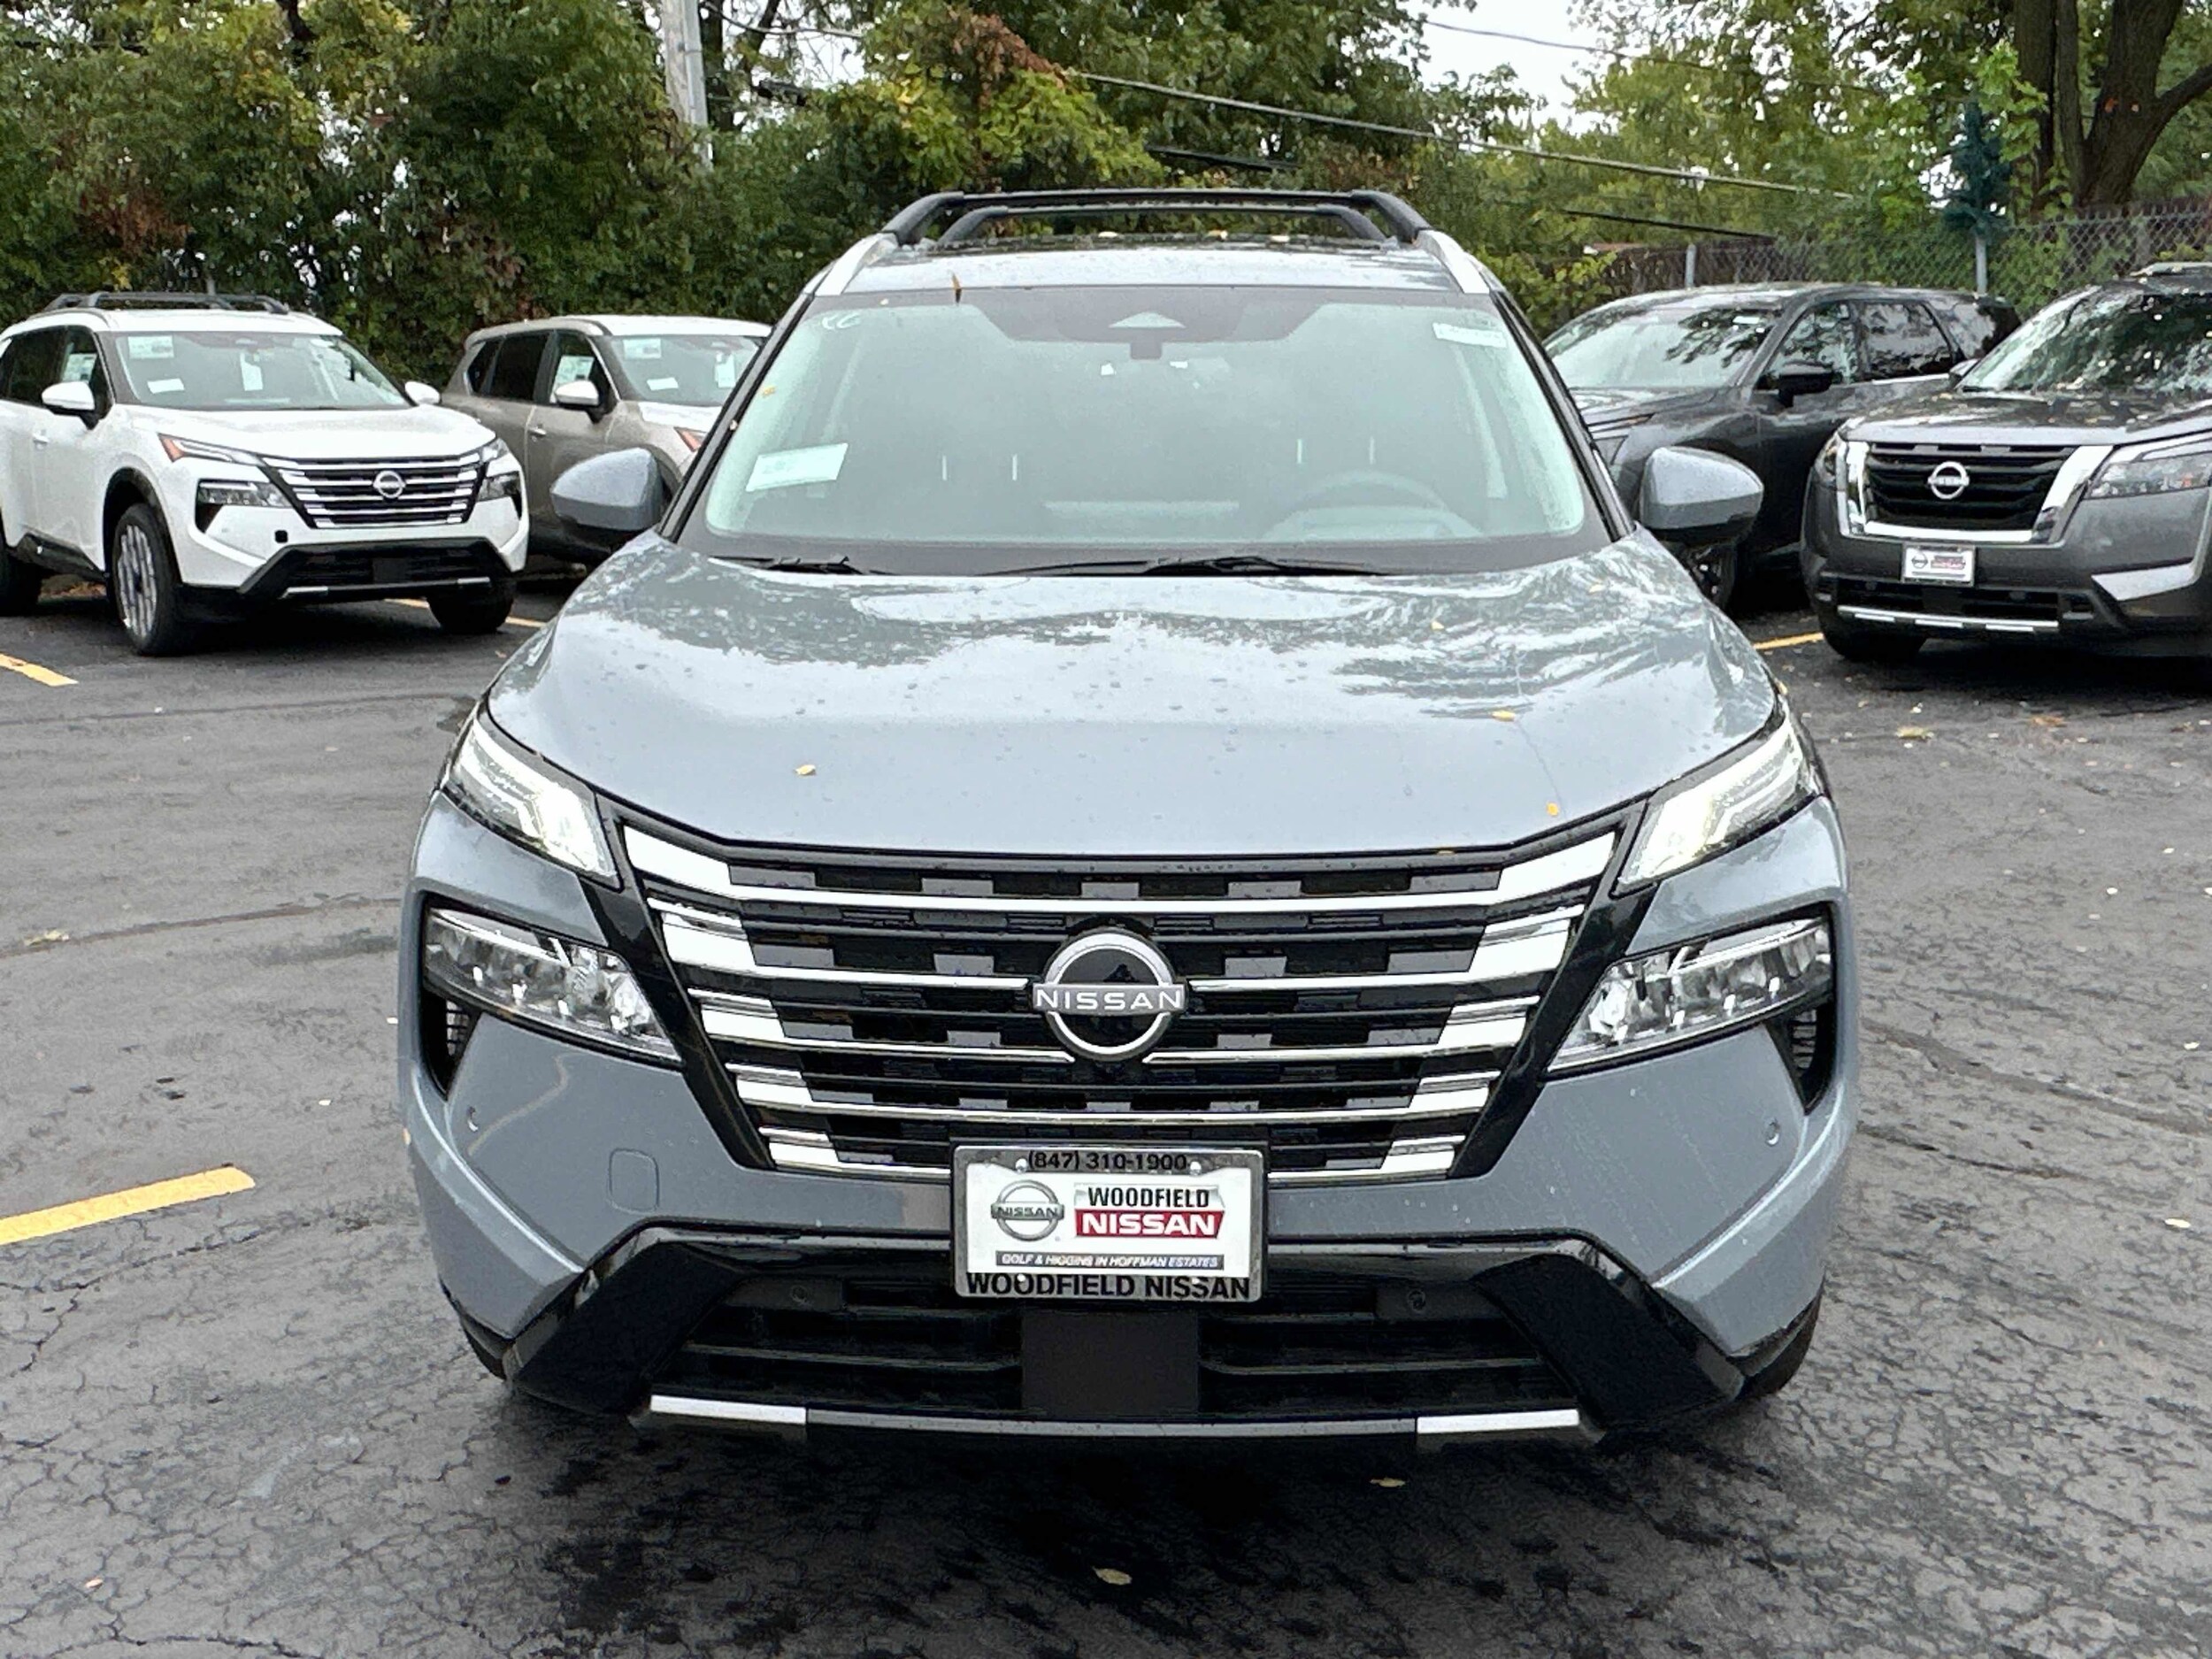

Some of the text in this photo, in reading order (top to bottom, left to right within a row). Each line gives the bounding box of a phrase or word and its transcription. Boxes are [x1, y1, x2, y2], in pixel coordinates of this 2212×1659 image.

[1036, 989, 1180, 1010] NISSAN
[1029, 1150, 1187, 1171] (847) 310-1900
[1088, 1187, 1210, 1208] WOODFIELD
[997, 1206, 1058, 1217] NISSAN
[1082, 1212, 1215, 1235] NISSAN
[1002, 1254, 1033, 1264] GOLF
[1095, 1256, 1108, 1266] IN
[1109, 1256, 1167, 1267] HOFFMAN
[1168, 1256, 1218, 1268] ESTATES
[966, 1272, 1249, 1299] WOODFIELD NISSAN
